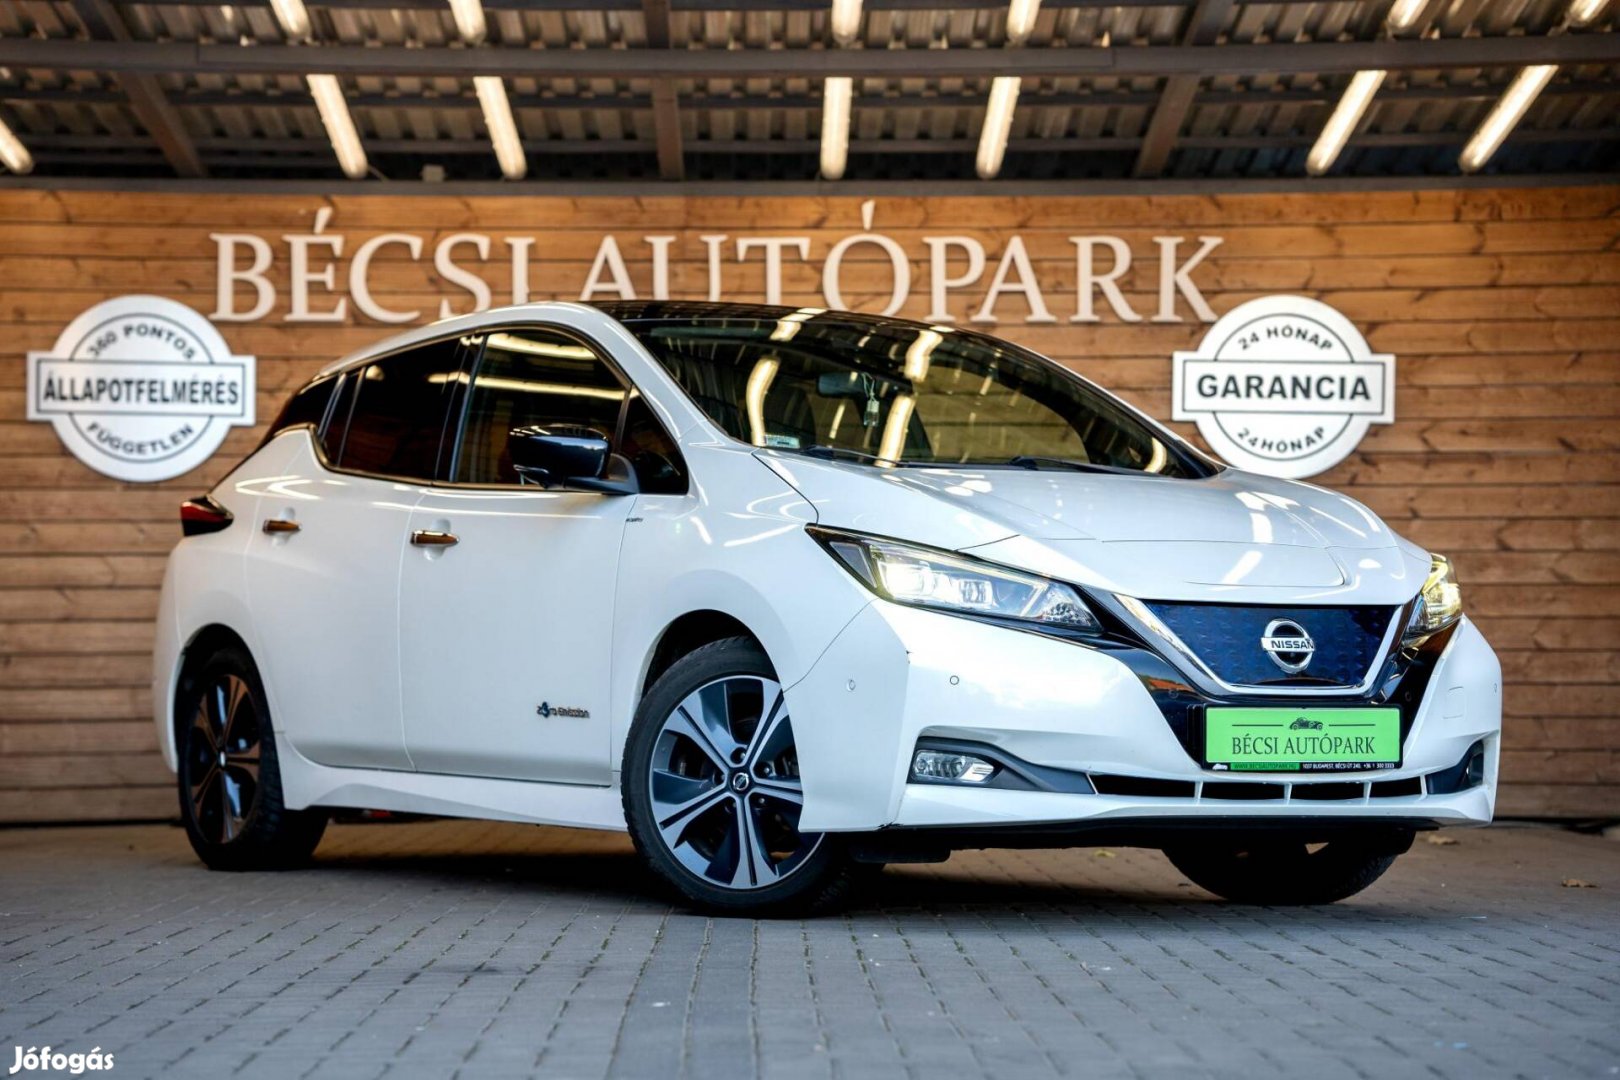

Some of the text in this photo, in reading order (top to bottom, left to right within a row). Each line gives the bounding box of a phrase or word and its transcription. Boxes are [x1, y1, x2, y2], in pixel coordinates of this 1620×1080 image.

[208, 200, 1224, 323] BÉCSI AUTÓPARK
[87, 323, 197, 361] 360 PONTOS
[1238, 324, 1333, 352] 24 HÓNAP
[43, 369, 239, 405] ÁLLAPOTFELMÉRÉS
[1196, 374, 1371, 401] GARANCIA
[86, 421, 194, 455] FÜGGETLEN
[1271, 639, 1314, 649] NISSAN
[1231, 733, 1376, 755] BÉCSI AUTÓPARK
